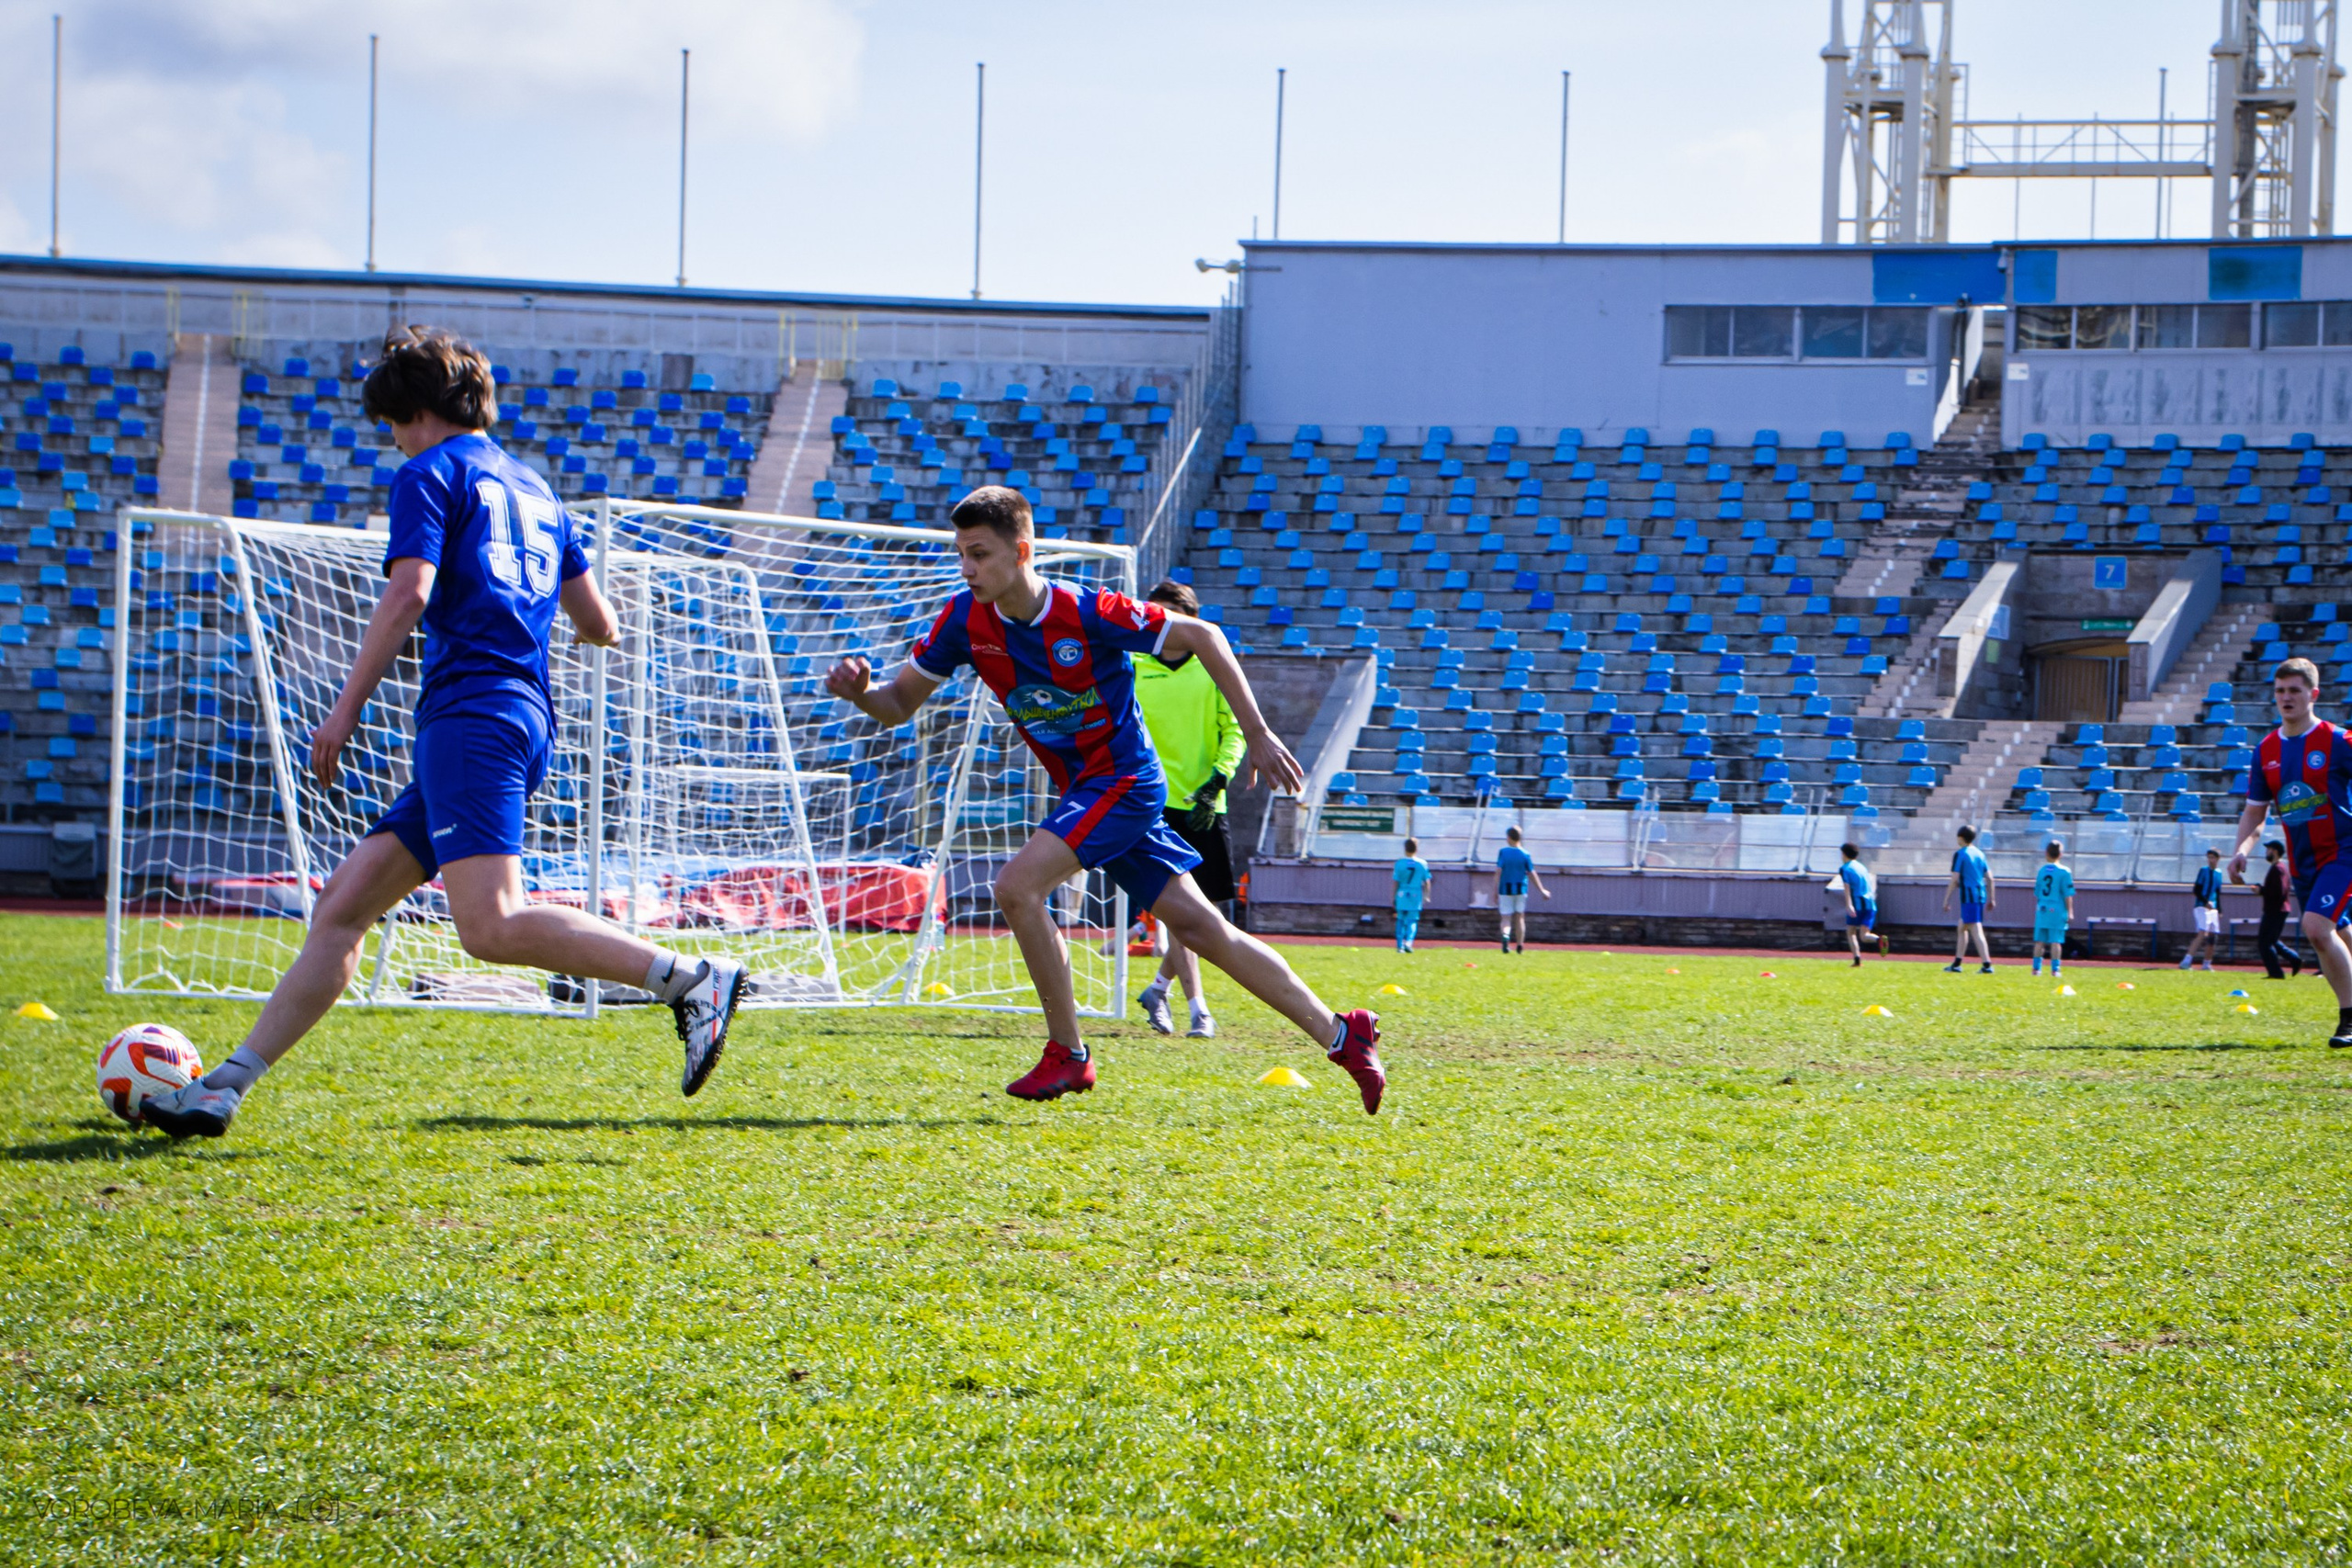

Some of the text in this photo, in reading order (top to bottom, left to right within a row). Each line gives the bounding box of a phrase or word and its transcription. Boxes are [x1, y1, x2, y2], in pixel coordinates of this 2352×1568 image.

[475, 480, 560, 599] 15
[2104, 564, 2116, 580] 7
[1055, 800, 1086, 824] 7
[1407, 867, 1416, 885] 7
[2042, 874, 2053, 897] 3
[2320, 894, 2335, 908] 9
